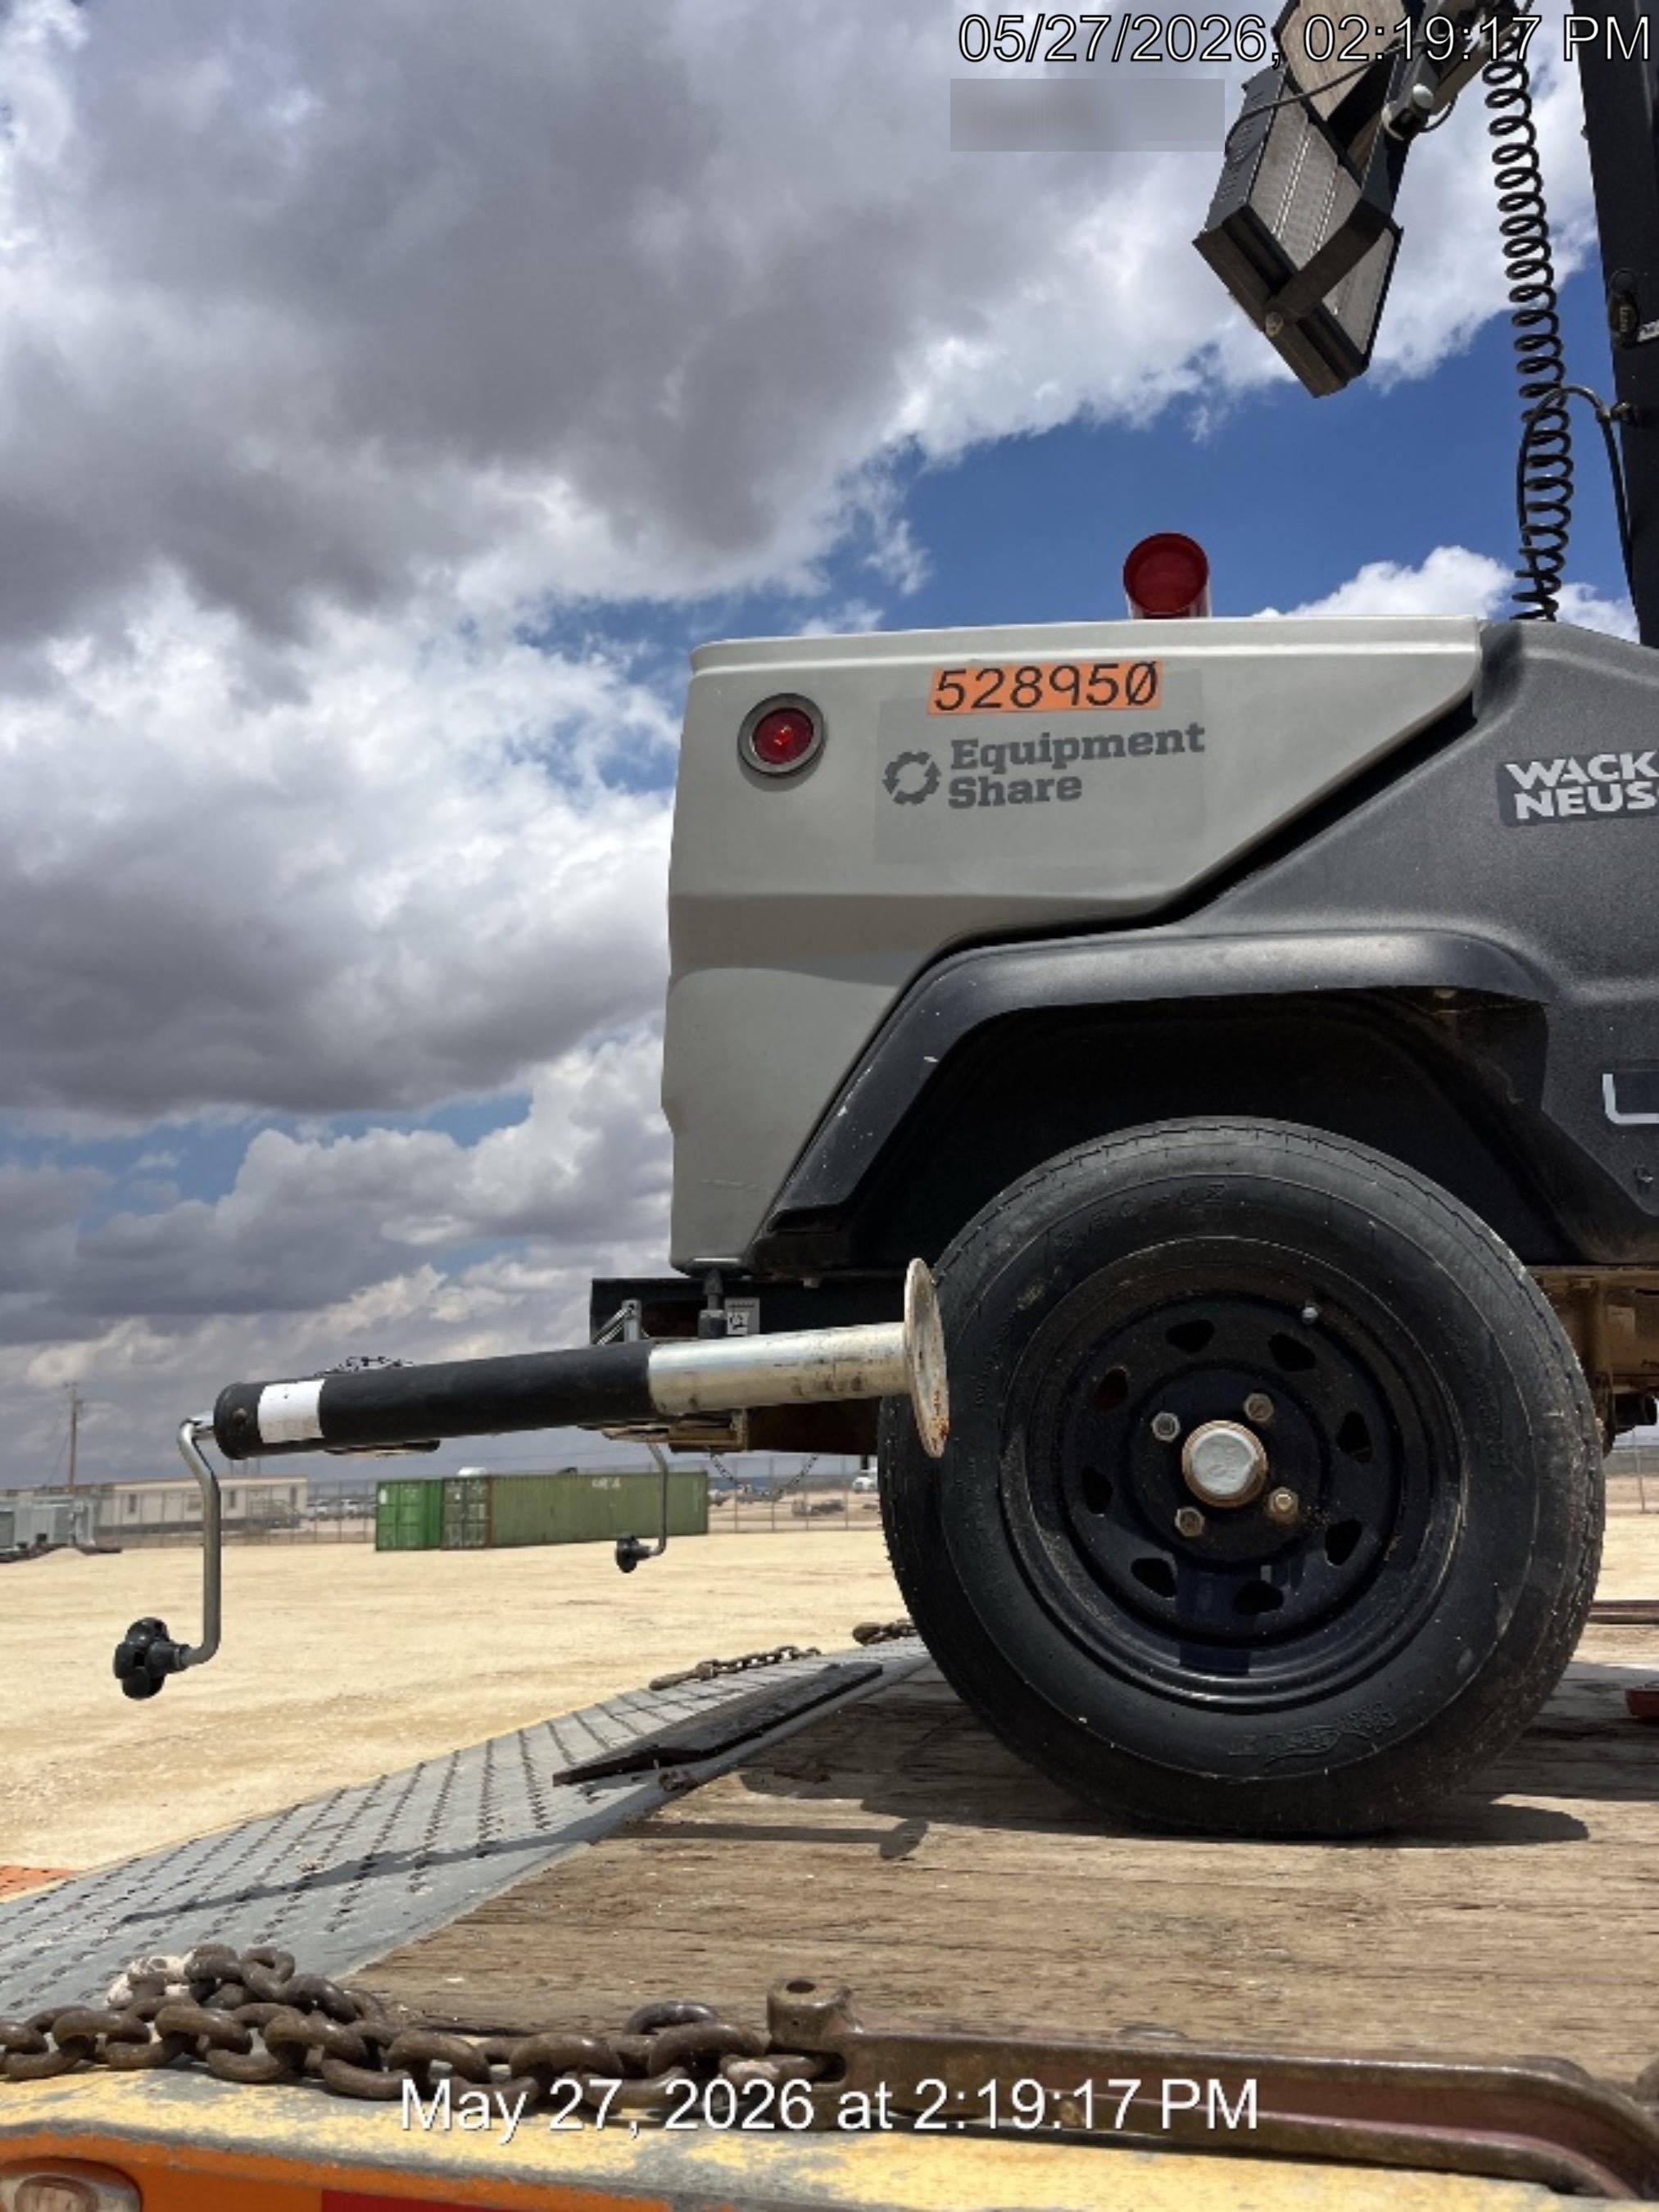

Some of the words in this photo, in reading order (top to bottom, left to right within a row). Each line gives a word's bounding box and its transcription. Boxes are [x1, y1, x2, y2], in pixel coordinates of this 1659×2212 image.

[934, 661, 1158, 711] 528950
[950, 722, 1206, 774] Equipment
[1505, 750, 1659, 790] WACK
[948, 774, 1082, 809] Share
[1514, 780, 1659, 820] NEUS
